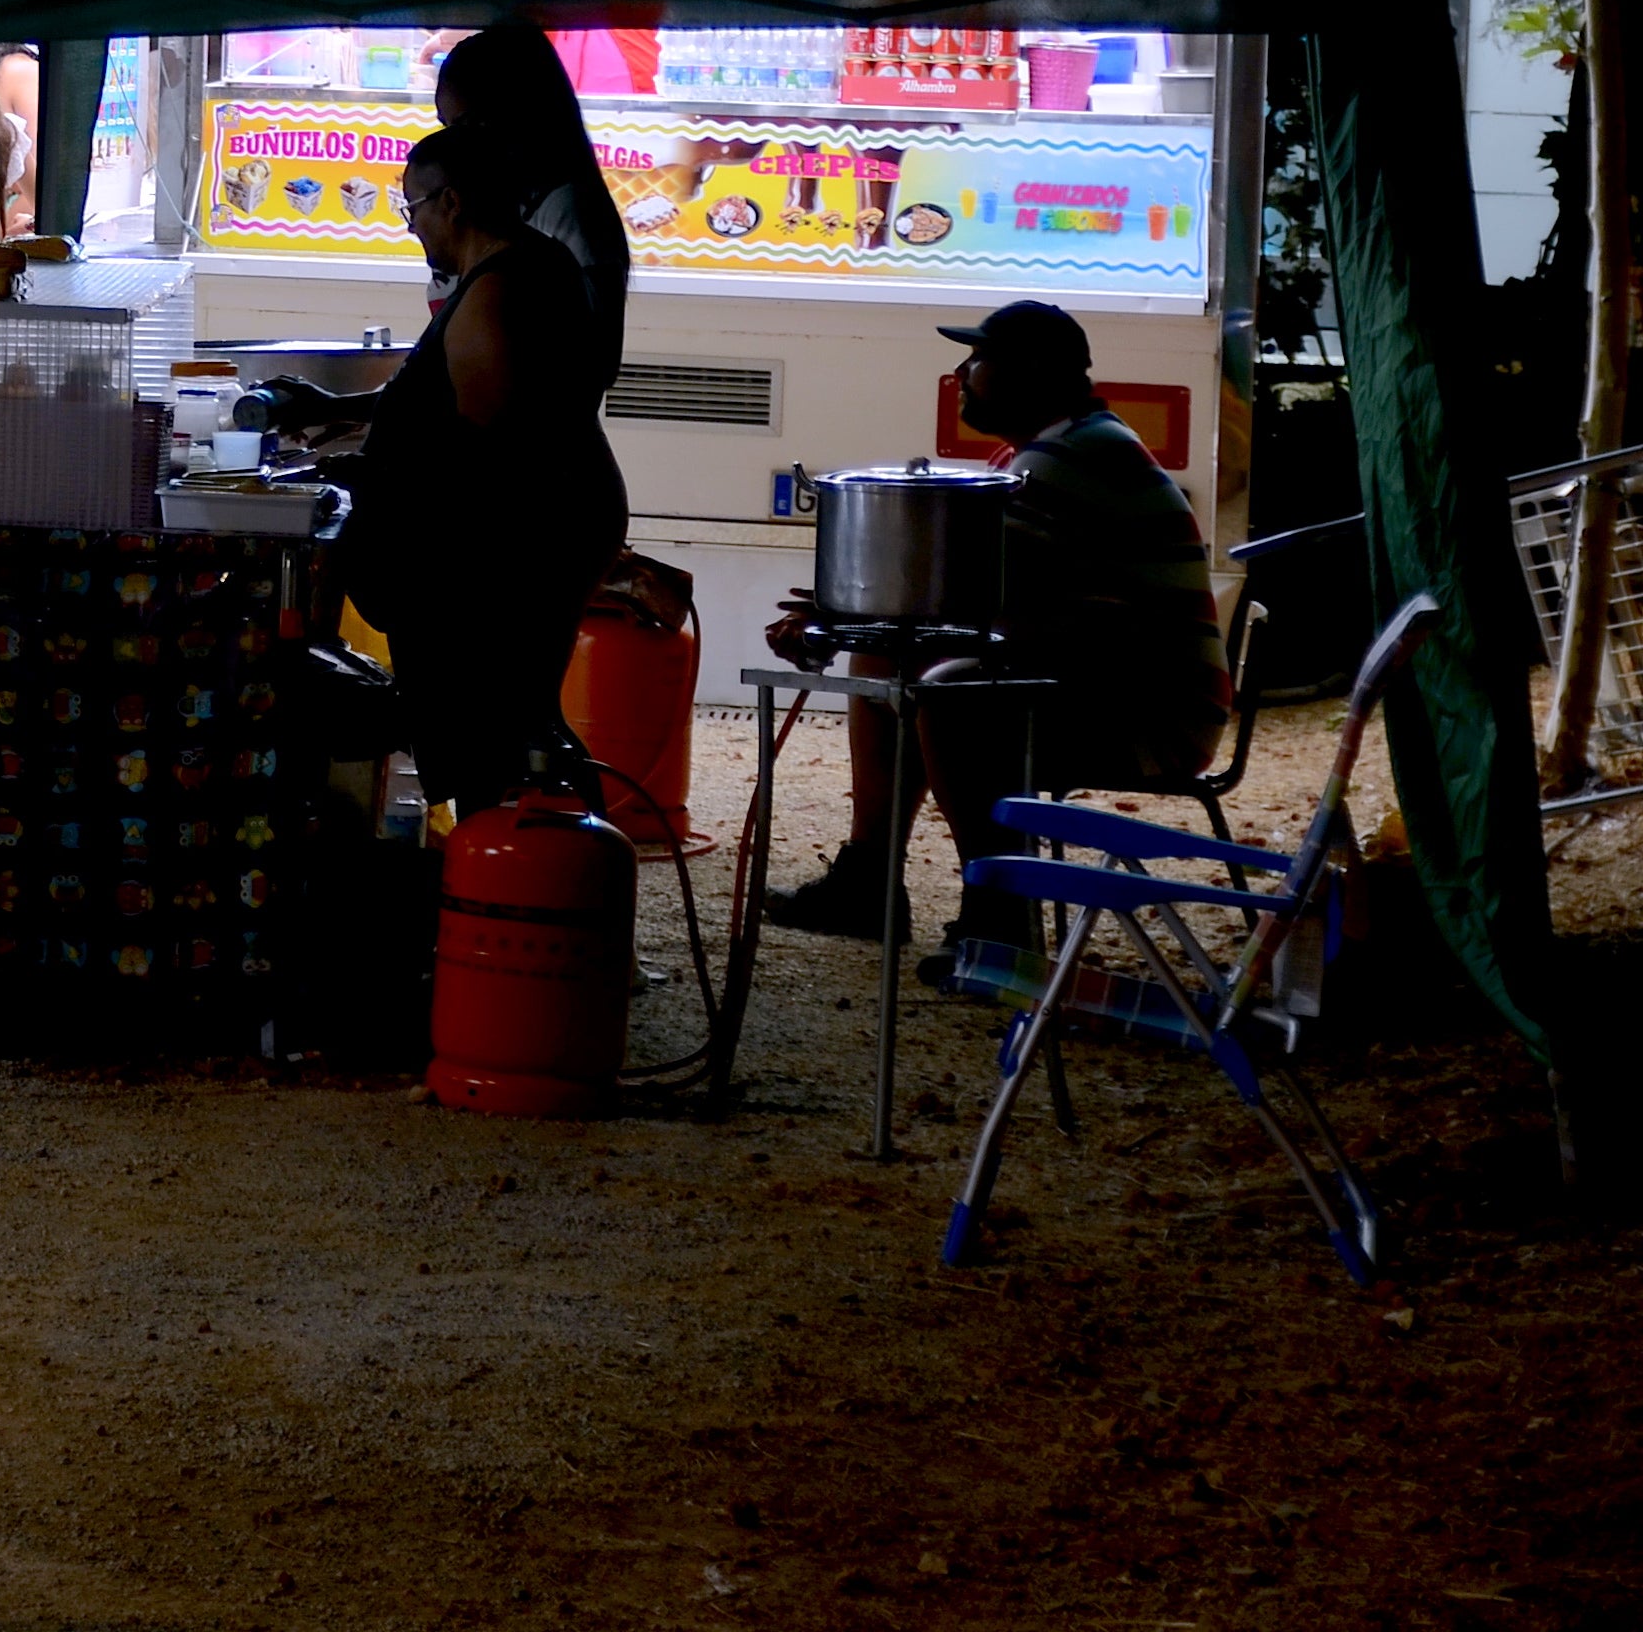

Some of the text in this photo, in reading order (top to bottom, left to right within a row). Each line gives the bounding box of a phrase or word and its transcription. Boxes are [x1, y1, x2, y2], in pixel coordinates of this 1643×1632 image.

[899, 79, 957, 94] Alhambra
[229, 125, 412, 162] BUÑUELOS ORB
[589, 143, 654, 169] ELGAS
[749, 153, 901, 181] CREPES
